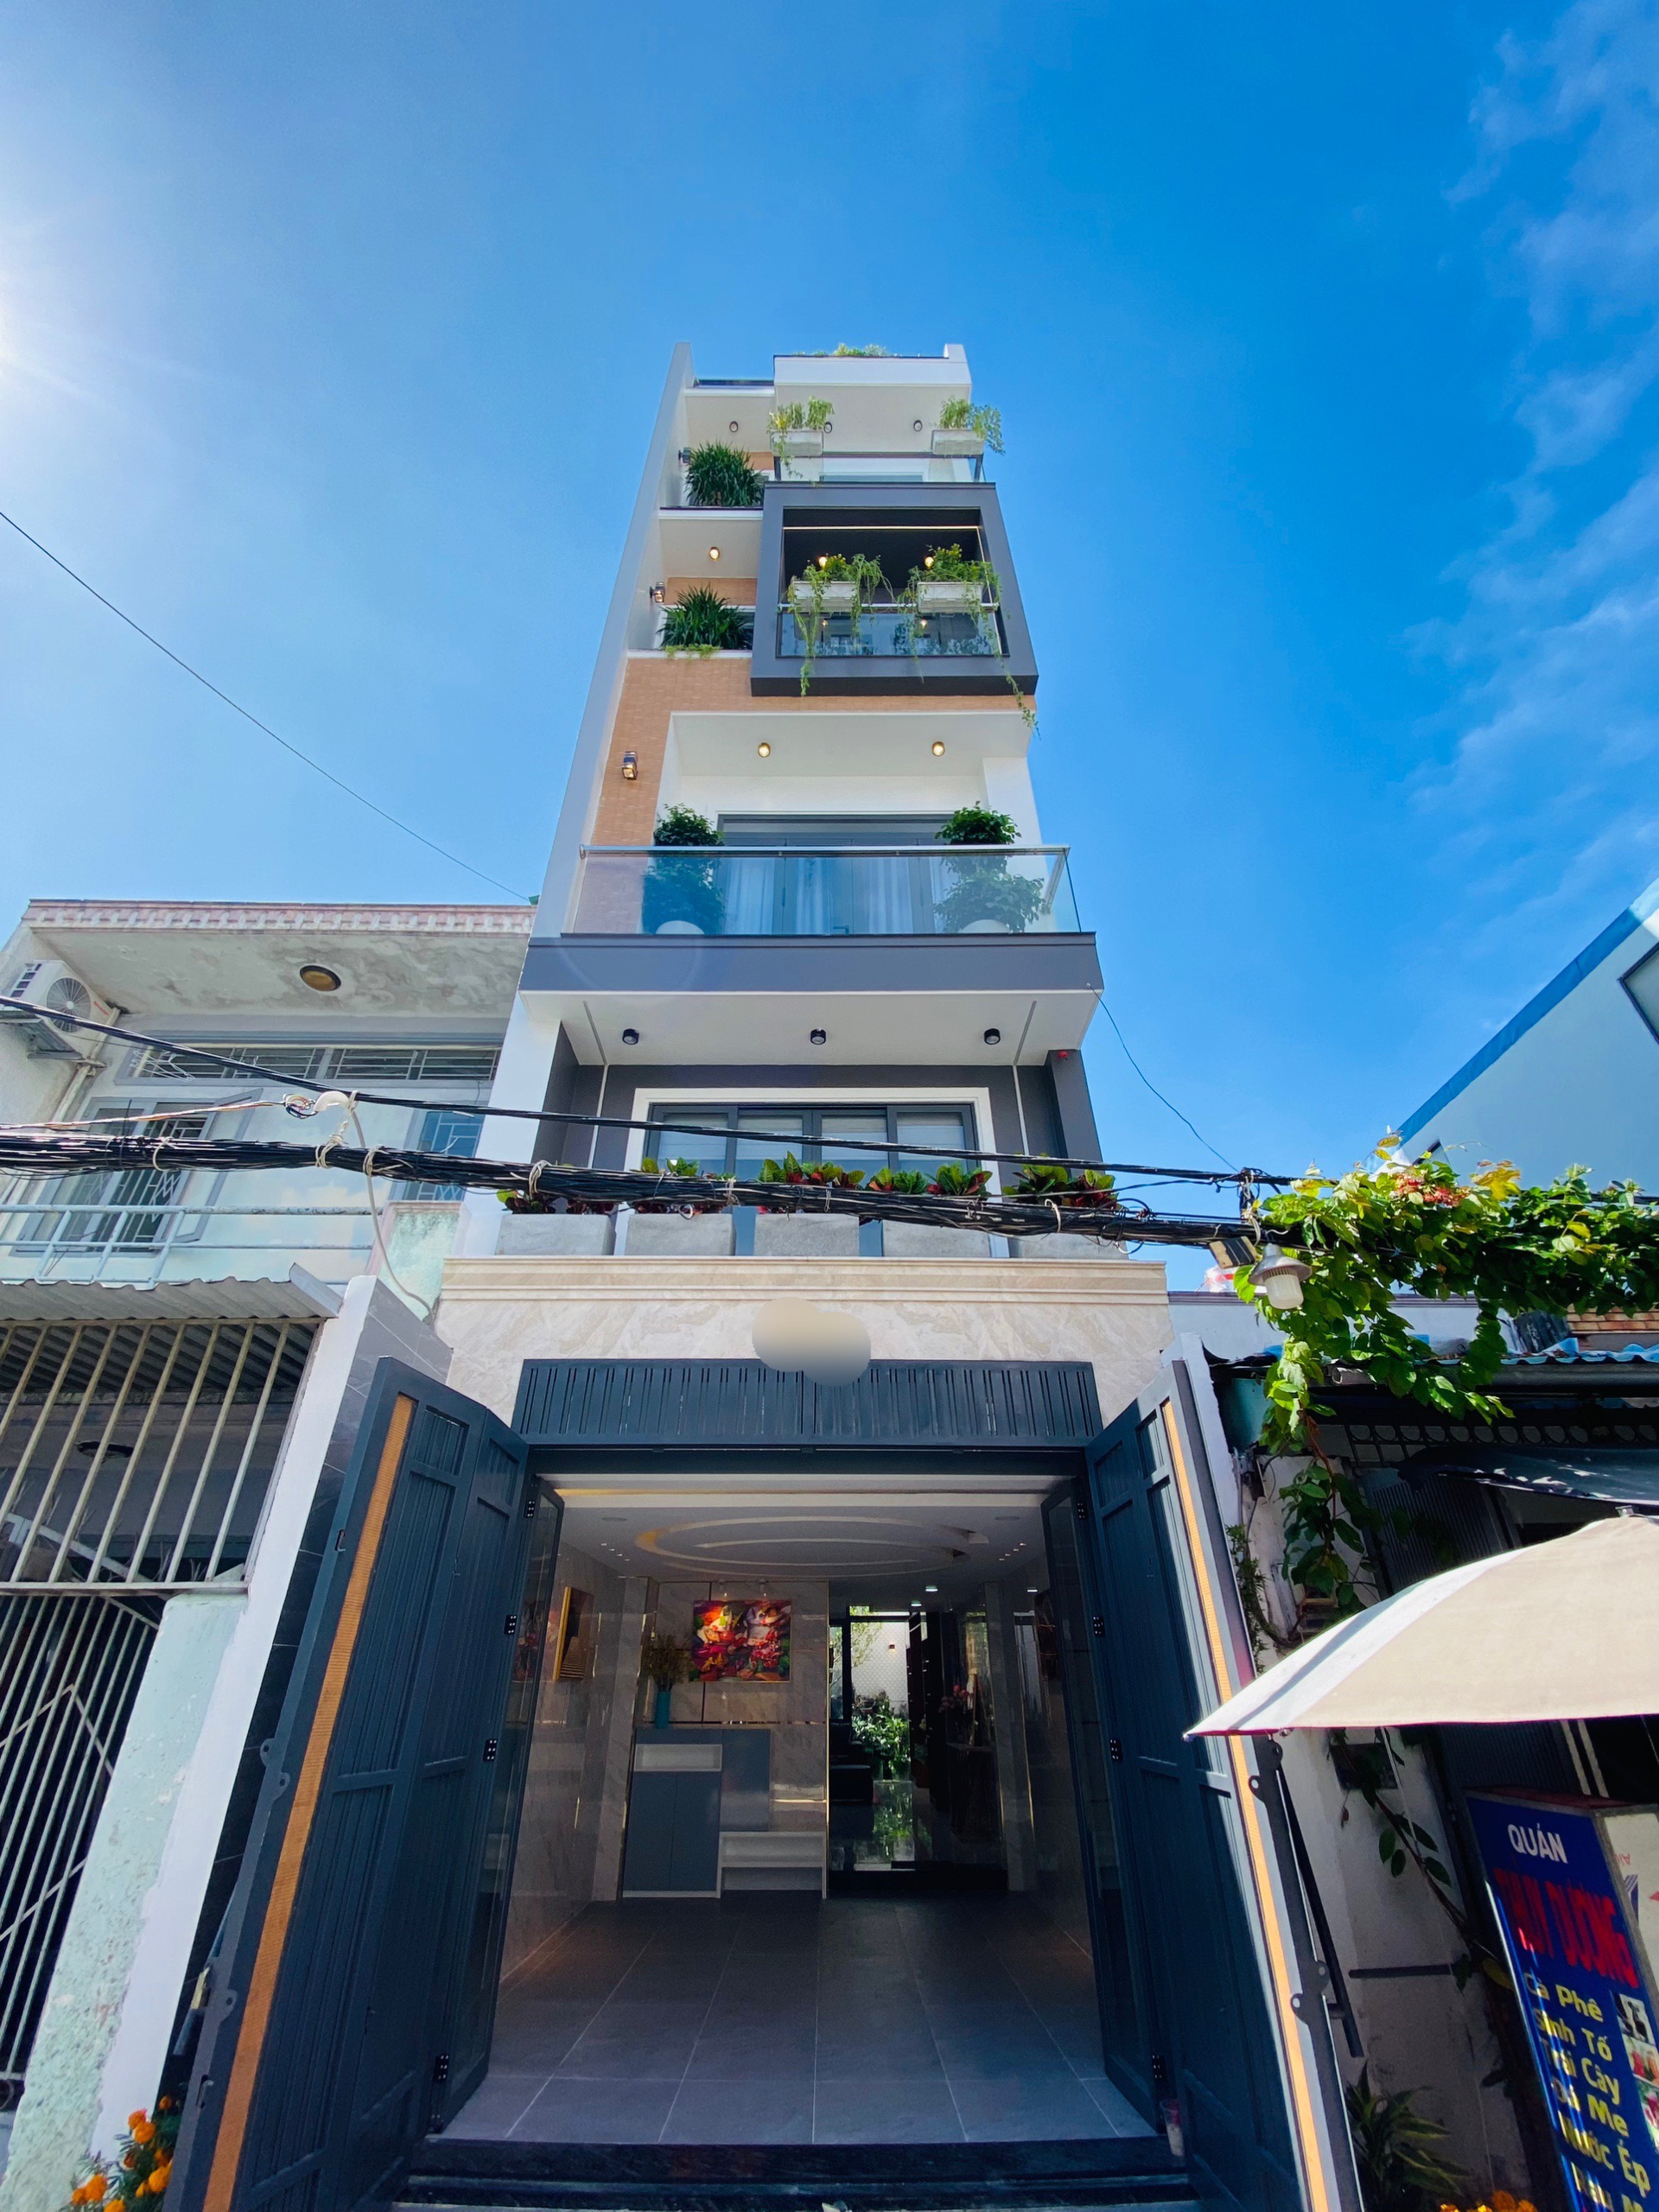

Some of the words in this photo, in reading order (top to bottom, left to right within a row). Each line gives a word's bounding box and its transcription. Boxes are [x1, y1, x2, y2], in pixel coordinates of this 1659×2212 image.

[1508, 1822, 1568, 1864] QUÁN
[1523, 1972, 1550, 2000] Cà
[1555, 1984, 1604, 2023] Phê
[1533, 2008, 1576, 2046] Sinh
[1580, 2027, 1612, 2062] Tố
[1581, 2057, 1620, 2106] Cây
[1587, 2094, 1630, 2139] Me
[1557, 2110, 1614, 2171] Nước
[1617, 2139, 1651, 2198] Ép
